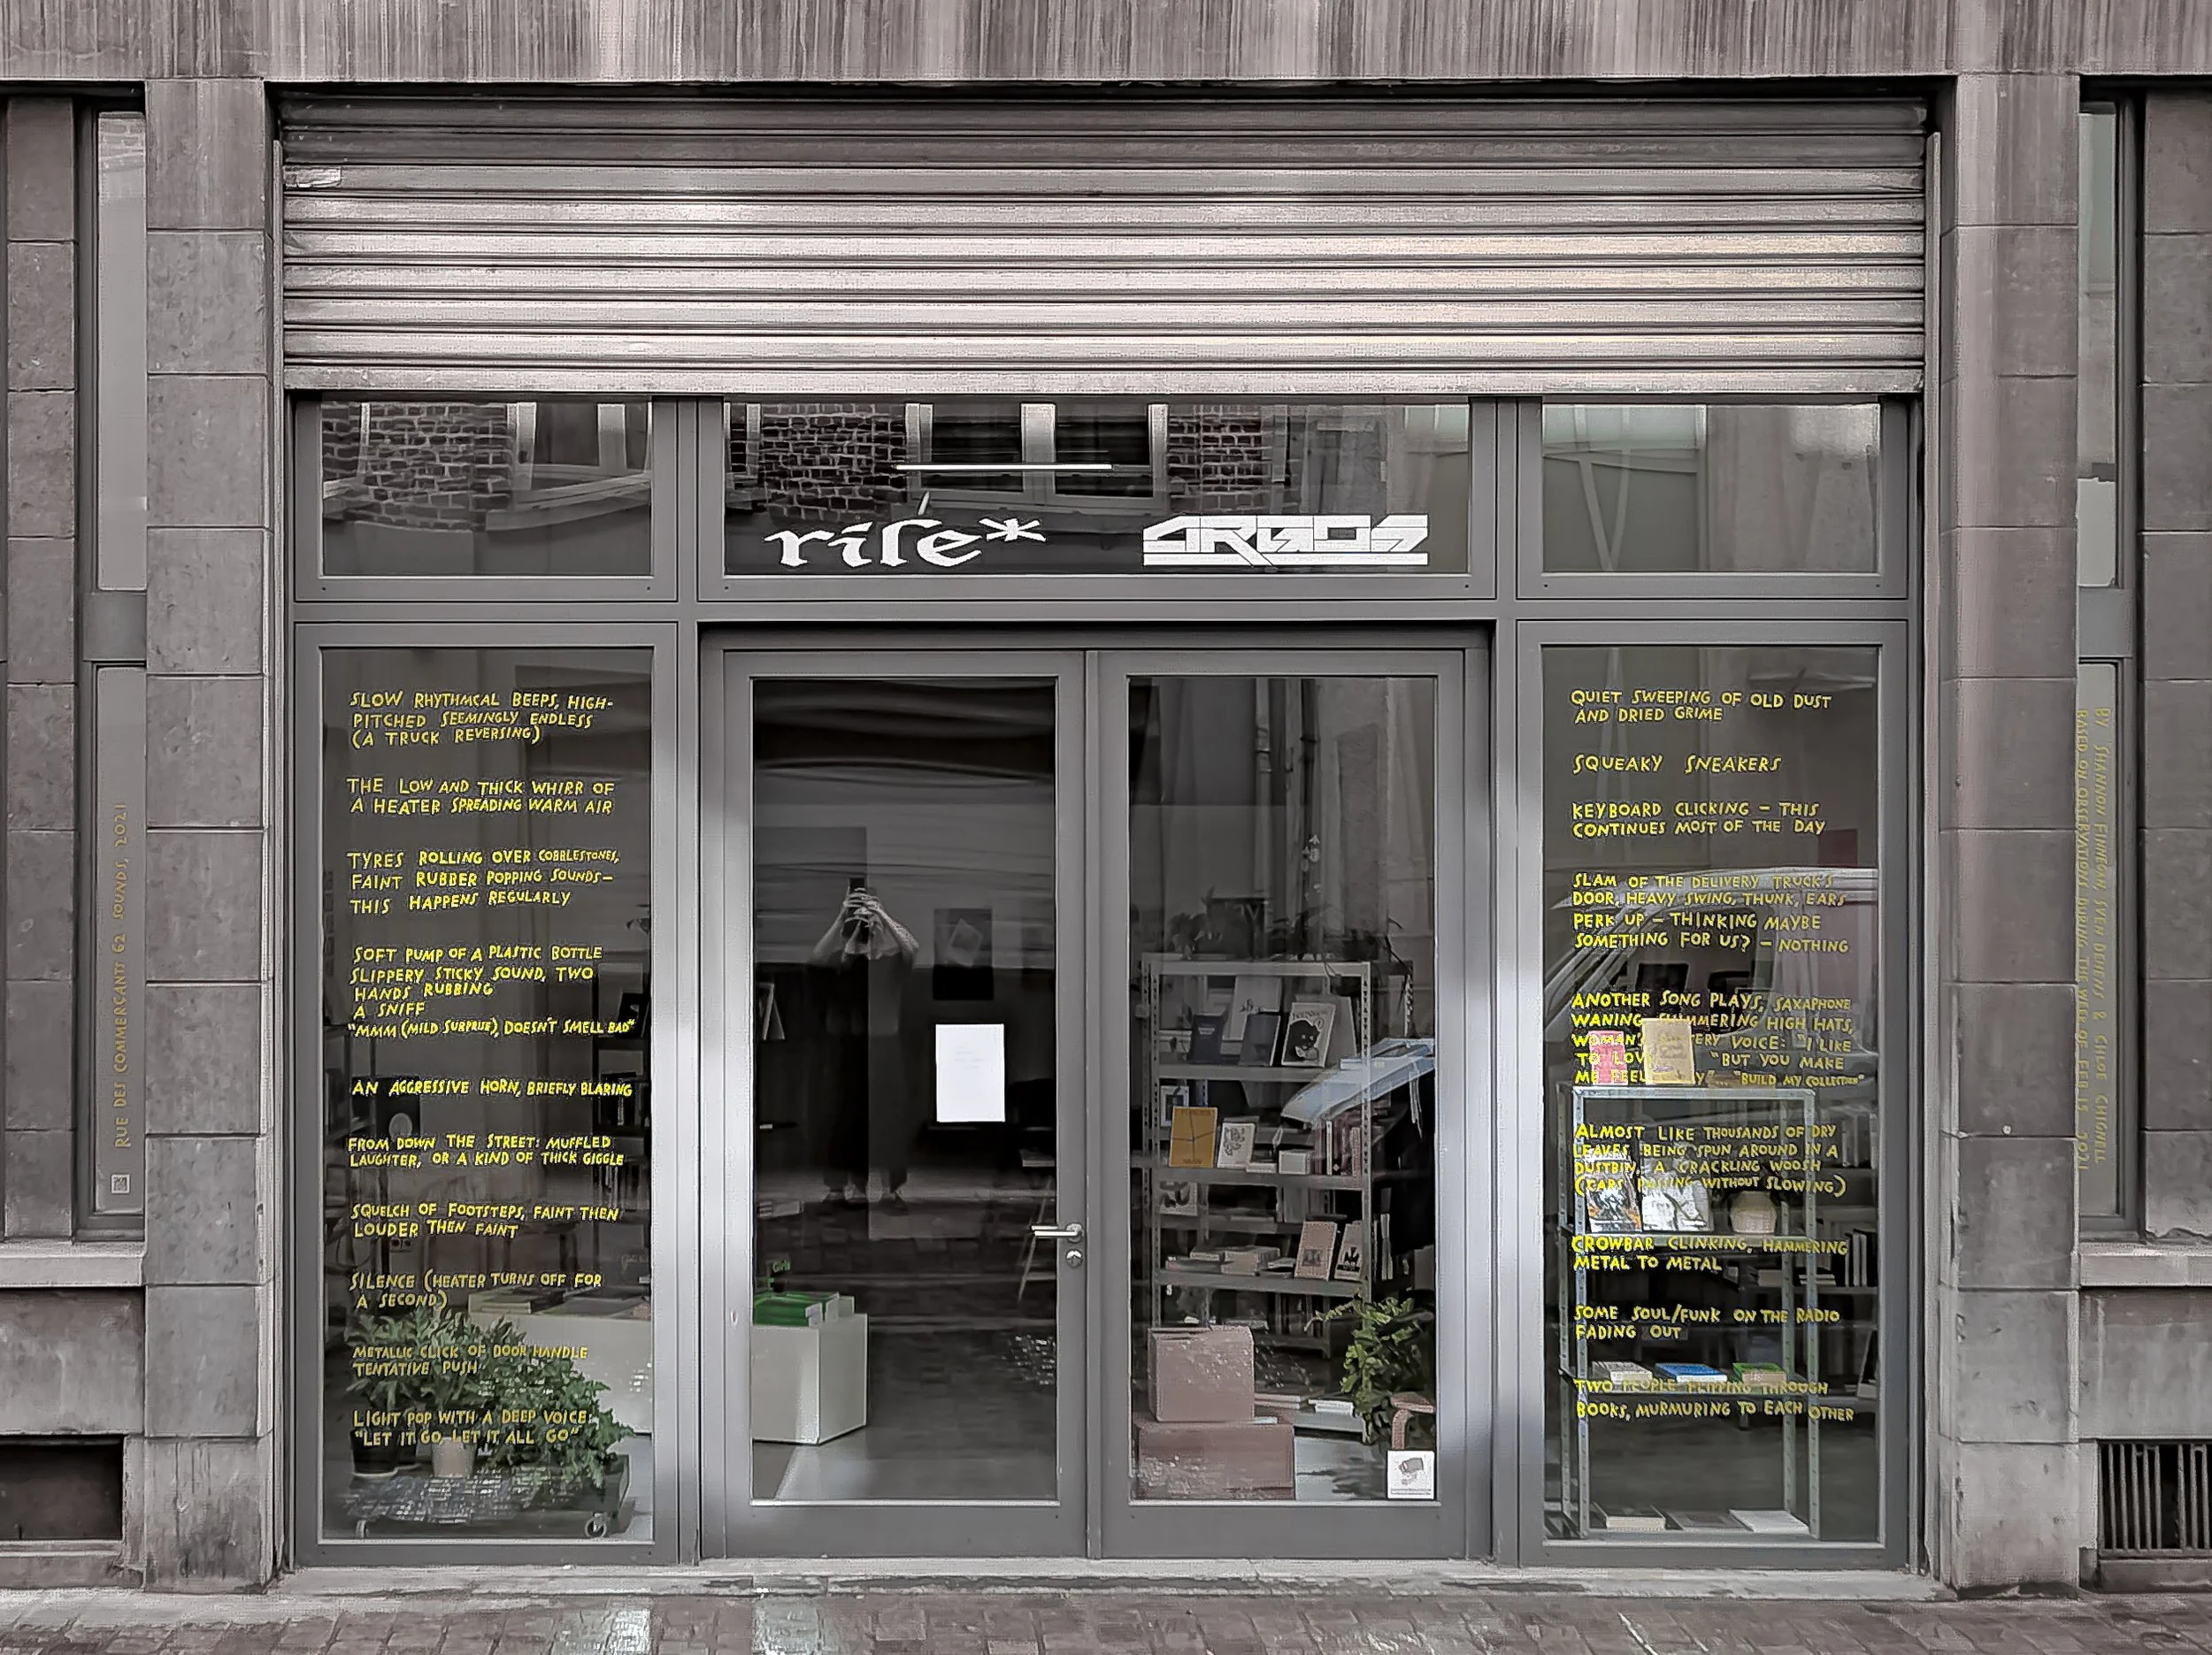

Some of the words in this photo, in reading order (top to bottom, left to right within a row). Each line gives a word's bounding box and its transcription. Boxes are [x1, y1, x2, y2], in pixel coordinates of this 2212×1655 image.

[1142, 515, 1429, 568] ARGOS
[350, 693, 403, 708] SLOW
[1571, 690, 1620, 705] QUIET
[1633, 690, 1709, 704] SWEEPING
[1750, 693, 1784, 708] OLD
[1793, 694, 1829, 709] DUST
[353, 714, 426, 727] PITCHED
[441, 711, 518, 726] SEEMINGLY
[530, 713, 592, 729] ENDLESS
[1575, 709, 1609, 722] AND
[1618, 708, 1665, 722] DRIED
[1674, 707, 1721, 721] GRIME
[387, 732, 438, 745] TRUCK
[455, 724, 541, 742] REVERSING)
[1575, 755, 1661, 773] SQUEAKY
[1686, 755, 1780, 774] SNEAKERS
[346, 778, 381, 793] THE
[399, 779, 434, 794] LOW
[439, 779, 470, 793] AND
[480, 780, 523, 795] THICK
[532, 780, 584, 794] WHIRR
[373, 799, 441, 815] HEATER
[450, 797, 523, 813] SPREADING
[528, 798, 577, 811] WARM
[585, 800, 612, 812] AIR
[1572, 802, 1662, 819] KEYBOARD
[1674, 802, 1747, 816] CLICKING
[1781, 802, 1820, 815] THIS
[1572, 821, 1665, 837] CONTINUES
[1675, 821, 1715, 832] MOST
[1755, 821, 1778, 834] THE
[1794, 820, 1824, 836] DAY
[347, 852, 403, 868] TYRES
[419, 850, 483, 866] ROLLING
[492, 849, 531, 864] OVER
[351, 873, 402, 889] FAINT
[416, 870, 478, 886] RUBBER
[486, 870, 542, 885] POPPING
[1573, 873, 1617, 888] SLAM
[1655, 875, 1682, 886] THE
[1692, 877, 1758, 887] DELIVERY
[352, 900, 389, 913] THIS
[409, 892, 479, 909] HAPPENS
[488, 890, 570, 905] REGULARLY
[1626, 892, 1676, 905] HEAVY
[1807, 894, 1848, 908] EARS
[1573, 912, 1614, 929] PERK
[1624, 913, 1645, 926] UP
[1670, 912, 1756, 928] THINKING
[1764, 916, 1818, 929] MAYBE
[1575, 932, 1669, 948] SOMETHING
[1680, 931, 1710, 946] FOR
[1778, 939, 1846, 952] NOTHING
[355, 947, 396, 962] SOFT
[405, 947, 444, 963] PUMP
[488, 945, 541, 959] PLASTIC
[551, 946, 601, 960] BOTTLE
[352, 968, 425, 983] SLIPPERY
[435, 966, 484, 981] STICKY
[557, 966, 594, 980] TWO
[355, 985, 411, 1000] HANDS
[424, 982, 494, 996] RUBBING
[1571, 992, 1650, 1008] ANOTHER
[1661, 990, 1699, 1007] SONG
[377, 1001, 425, 1016] SNIFF
[564, 1020, 603, 1034] SMELL
[1766, 1019, 1806, 1032] HIGH
[1758, 1051, 1788, 1065] YOU
[1801, 1058, 1841, 1069] MAKE
[353, 1081, 379, 1093] AN
[389, 1079, 469, 1094] AGGRESSIVE
[526, 1081, 576, 1095] BRIEFLY
[580, 1081, 633, 1097] BLARING
[1574, 1122, 1643, 1139] ALMOST
[1704, 1126, 1778, 1138] THOUSANDS
[1811, 1125, 1835, 1138] DRY
[348, 1138, 389, 1150] FROM
[396, 1137, 437, 1150] DOWN
[447, 1133, 475, 1148] THE
[547, 1136, 611, 1149] MUFFLED
[1642, 1143, 1686, 1157] BEING
[1695, 1145, 1730, 1155] SPUN
[1740, 1145, 1797, 1156] AROUND
[432, 1151, 449, 1164] OR
[474, 1151, 511, 1165] KIND
[541, 1152, 577, 1162] THICK
[582, 1152, 624, 1166] GIGGLE
[1678, 1161, 1759, 1172] CRACKLING
[1771, 1161, 1820, 1170] WOOSH
[1701, 1177, 1759, 1188] WITHOUT
[1767, 1173, 1846, 1196] SLOWING)
[353, 1204, 410, 1218] SQUELCH
[534, 1205, 574, 1217] FAINT
[580, 1206, 619, 1221] THEN
[354, 1222, 419, 1237] LOUDER
[428, 1219, 465, 1232] THEN
[475, 1223, 518, 1239] FAINT
[1571, 1234, 1654, 1253] CROWBAR
[1763, 1240, 1847, 1253] HAMMERING
[1572, 1254, 1628, 1270] METAL
[1667, 1256, 1720, 1270] METAL
[349, 1274, 414, 1291] SILENCE
[492, 1273, 534, 1287] TURNS
[541, 1273, 565, 1283] OFF
[574, 1273, 602, 1285] FOR
[381, 1291, 447, 1309] SECOND)
[1575, 1304, 1617, 1320] SOME
[1733, 1309, 1756, 1320] ON
[1763, 1309, 1787, 1322] THE
[1796, 1309, 1839, 1322] RADIO
[1575, 1323, 1635, 1339] FADING
[1650, 1325, 1680, 1337] OUT
[420, 1346, 457, 1358] CLICK
[532, 1346, 588, 1360] HANDLE
[352, 1361, 428, 1375] TENTATIVE
[1573, 1378, 1614, 1393] TWO
[1636, 1402, 1728, 1415] MURMURING
[1764, 1401, 1802, 1416] EACH
[1809, 1406, 1853, 1419] OTHER
[439, 1411, 475, 1427] WITH
